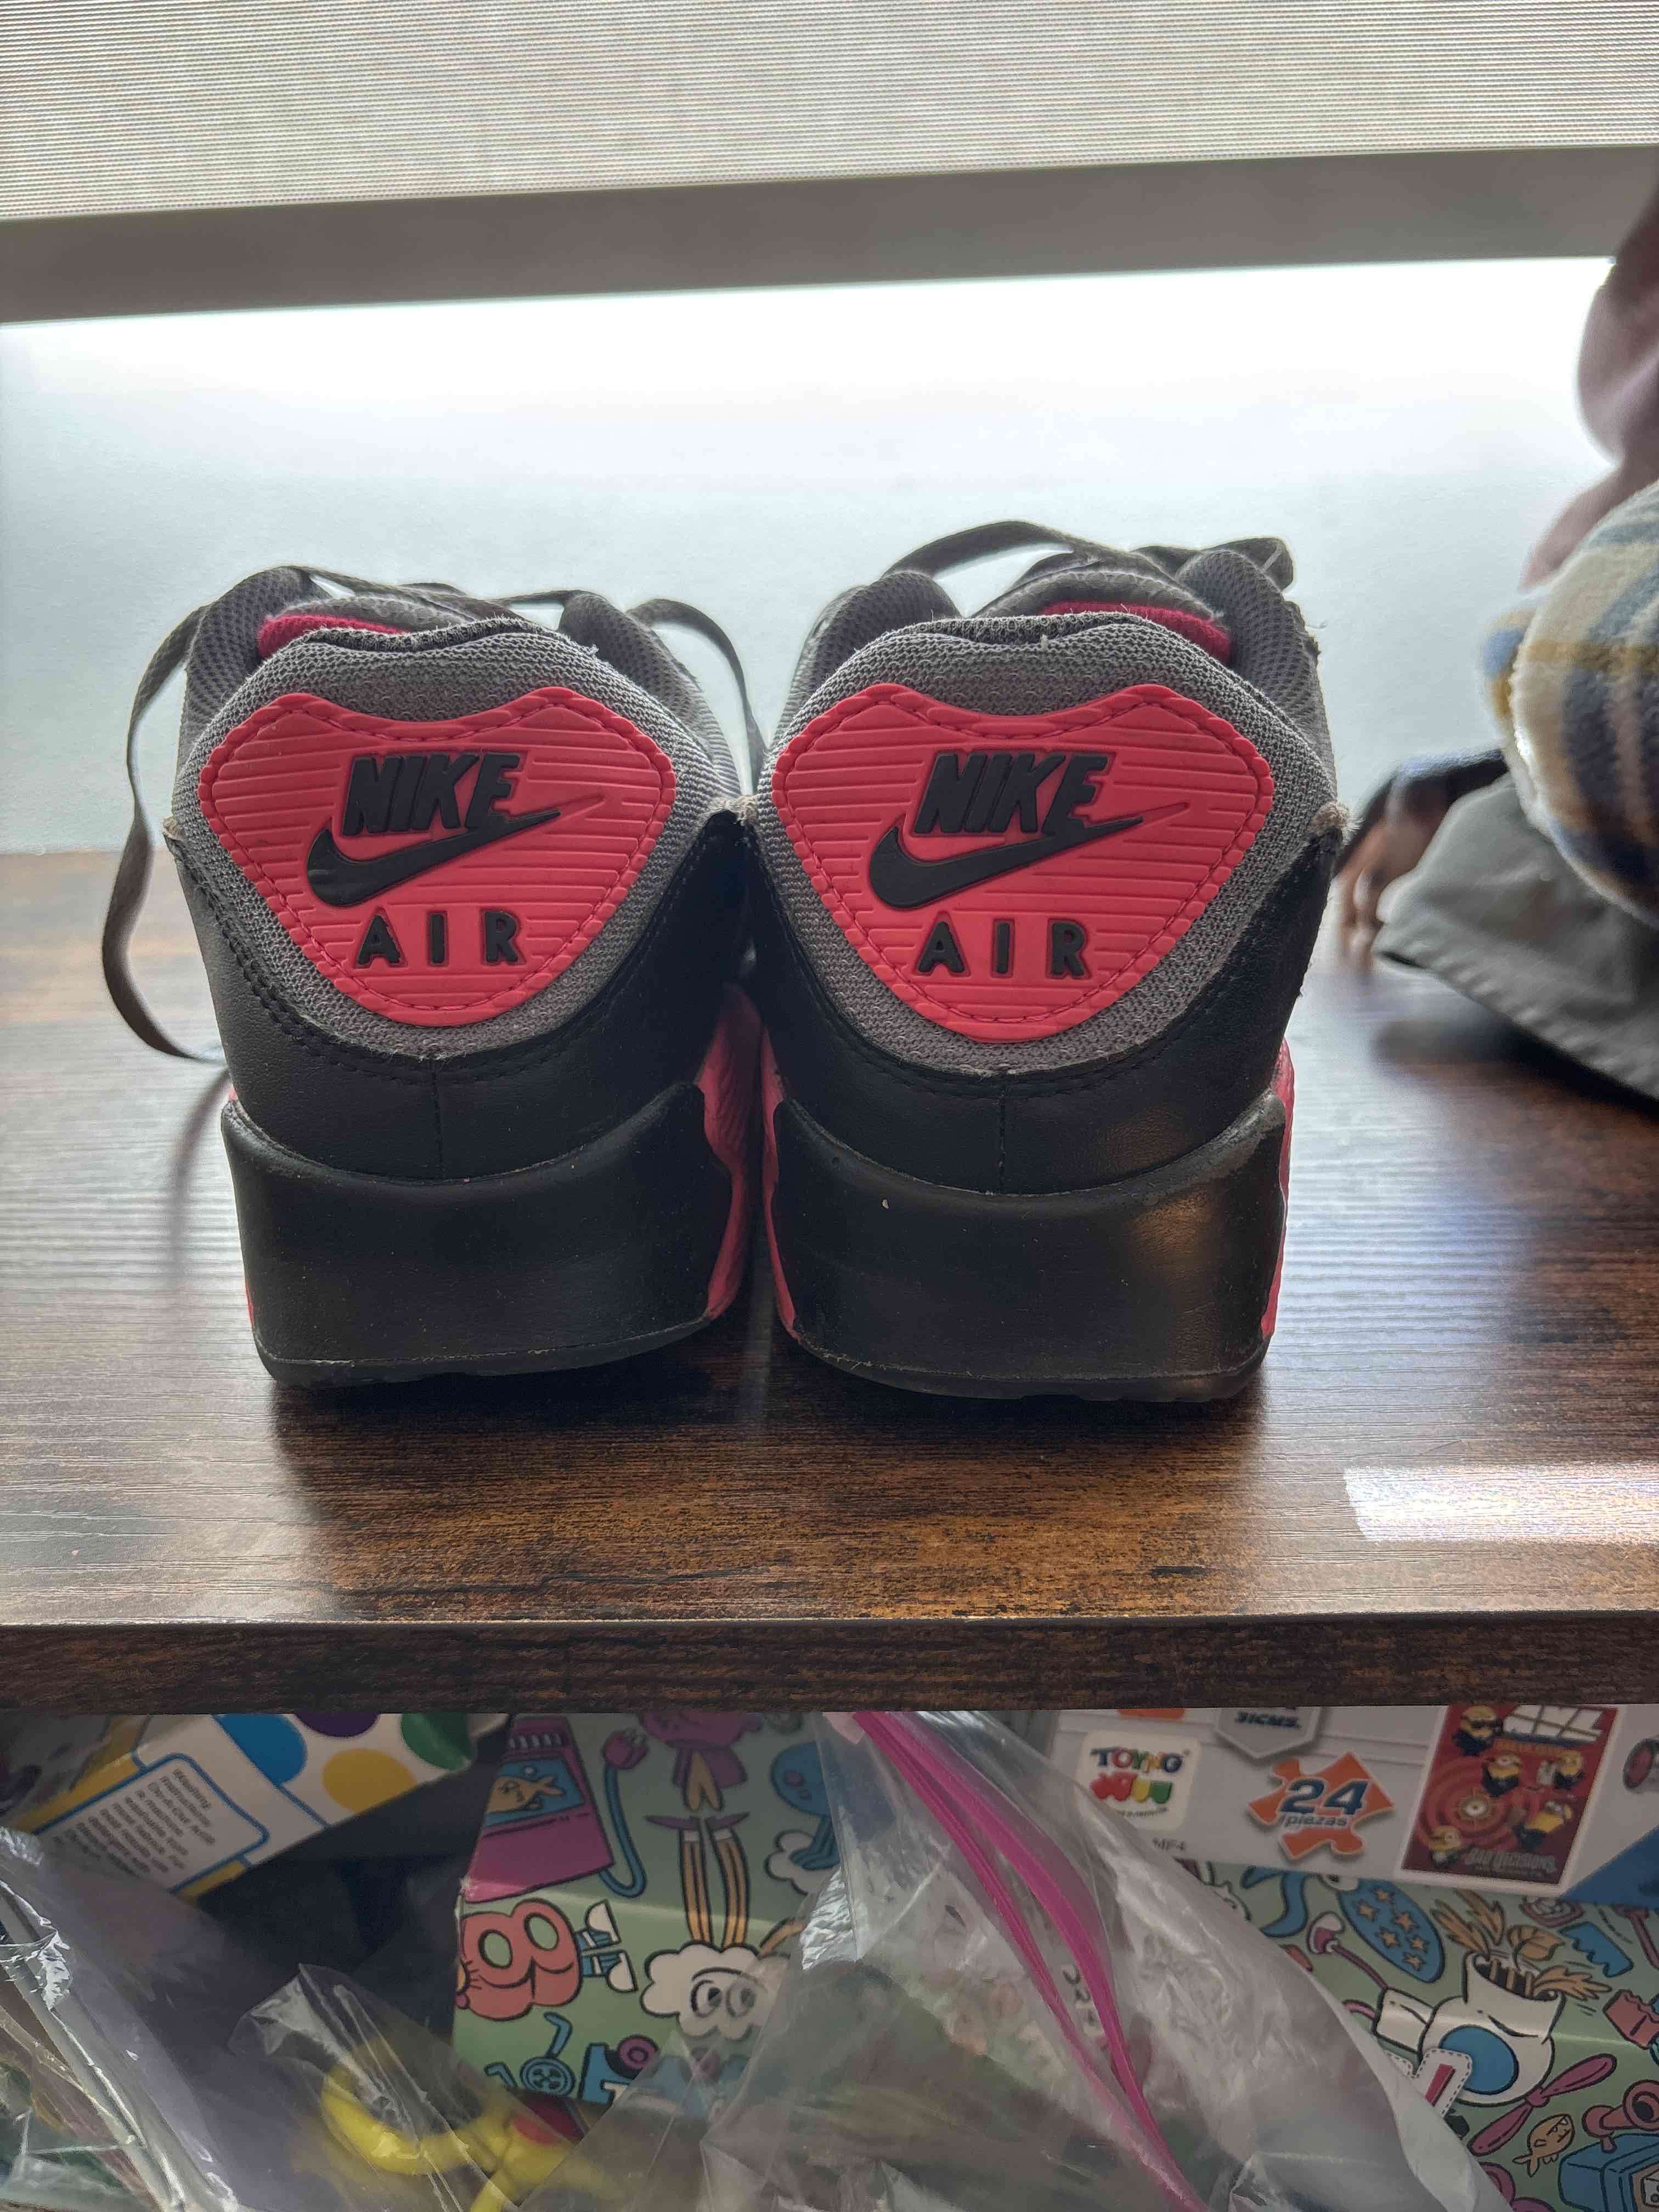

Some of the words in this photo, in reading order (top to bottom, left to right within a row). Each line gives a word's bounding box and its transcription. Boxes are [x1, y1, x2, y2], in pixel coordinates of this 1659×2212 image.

[342, 751, 521, 836] NIKE
[913, 754, 1109, 834] NIKE
[357, 911, 518, 965] AIR
[918, 921, 1086, 977] AIR
[1281, 1779, 1369, 1815] 24
[1283, 1813, 1348, 1828] piezas
